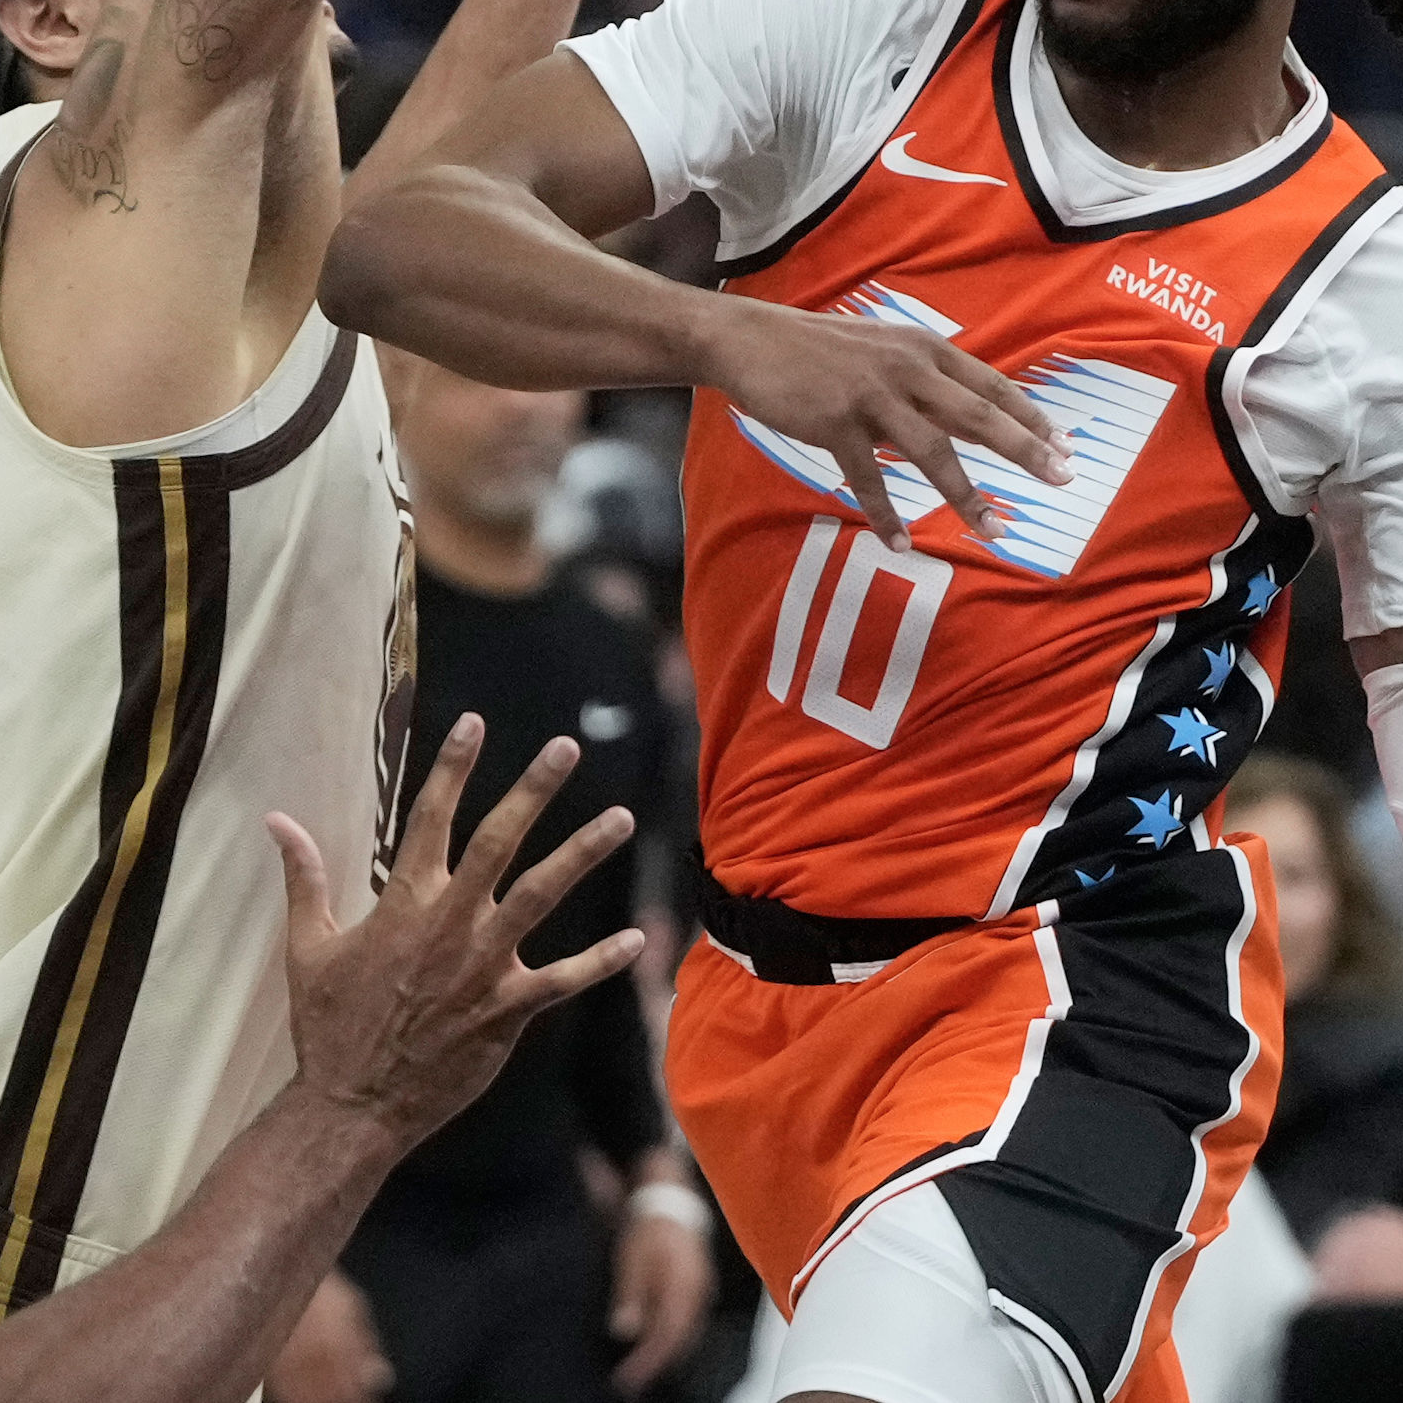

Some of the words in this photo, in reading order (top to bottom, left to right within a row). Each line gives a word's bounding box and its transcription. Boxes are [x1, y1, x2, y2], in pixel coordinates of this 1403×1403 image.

[1106, 264, 1225, 345] RWANDA
[1148, 257, 1218, 307] VISIT
[767, 514, 955, 751] 10
